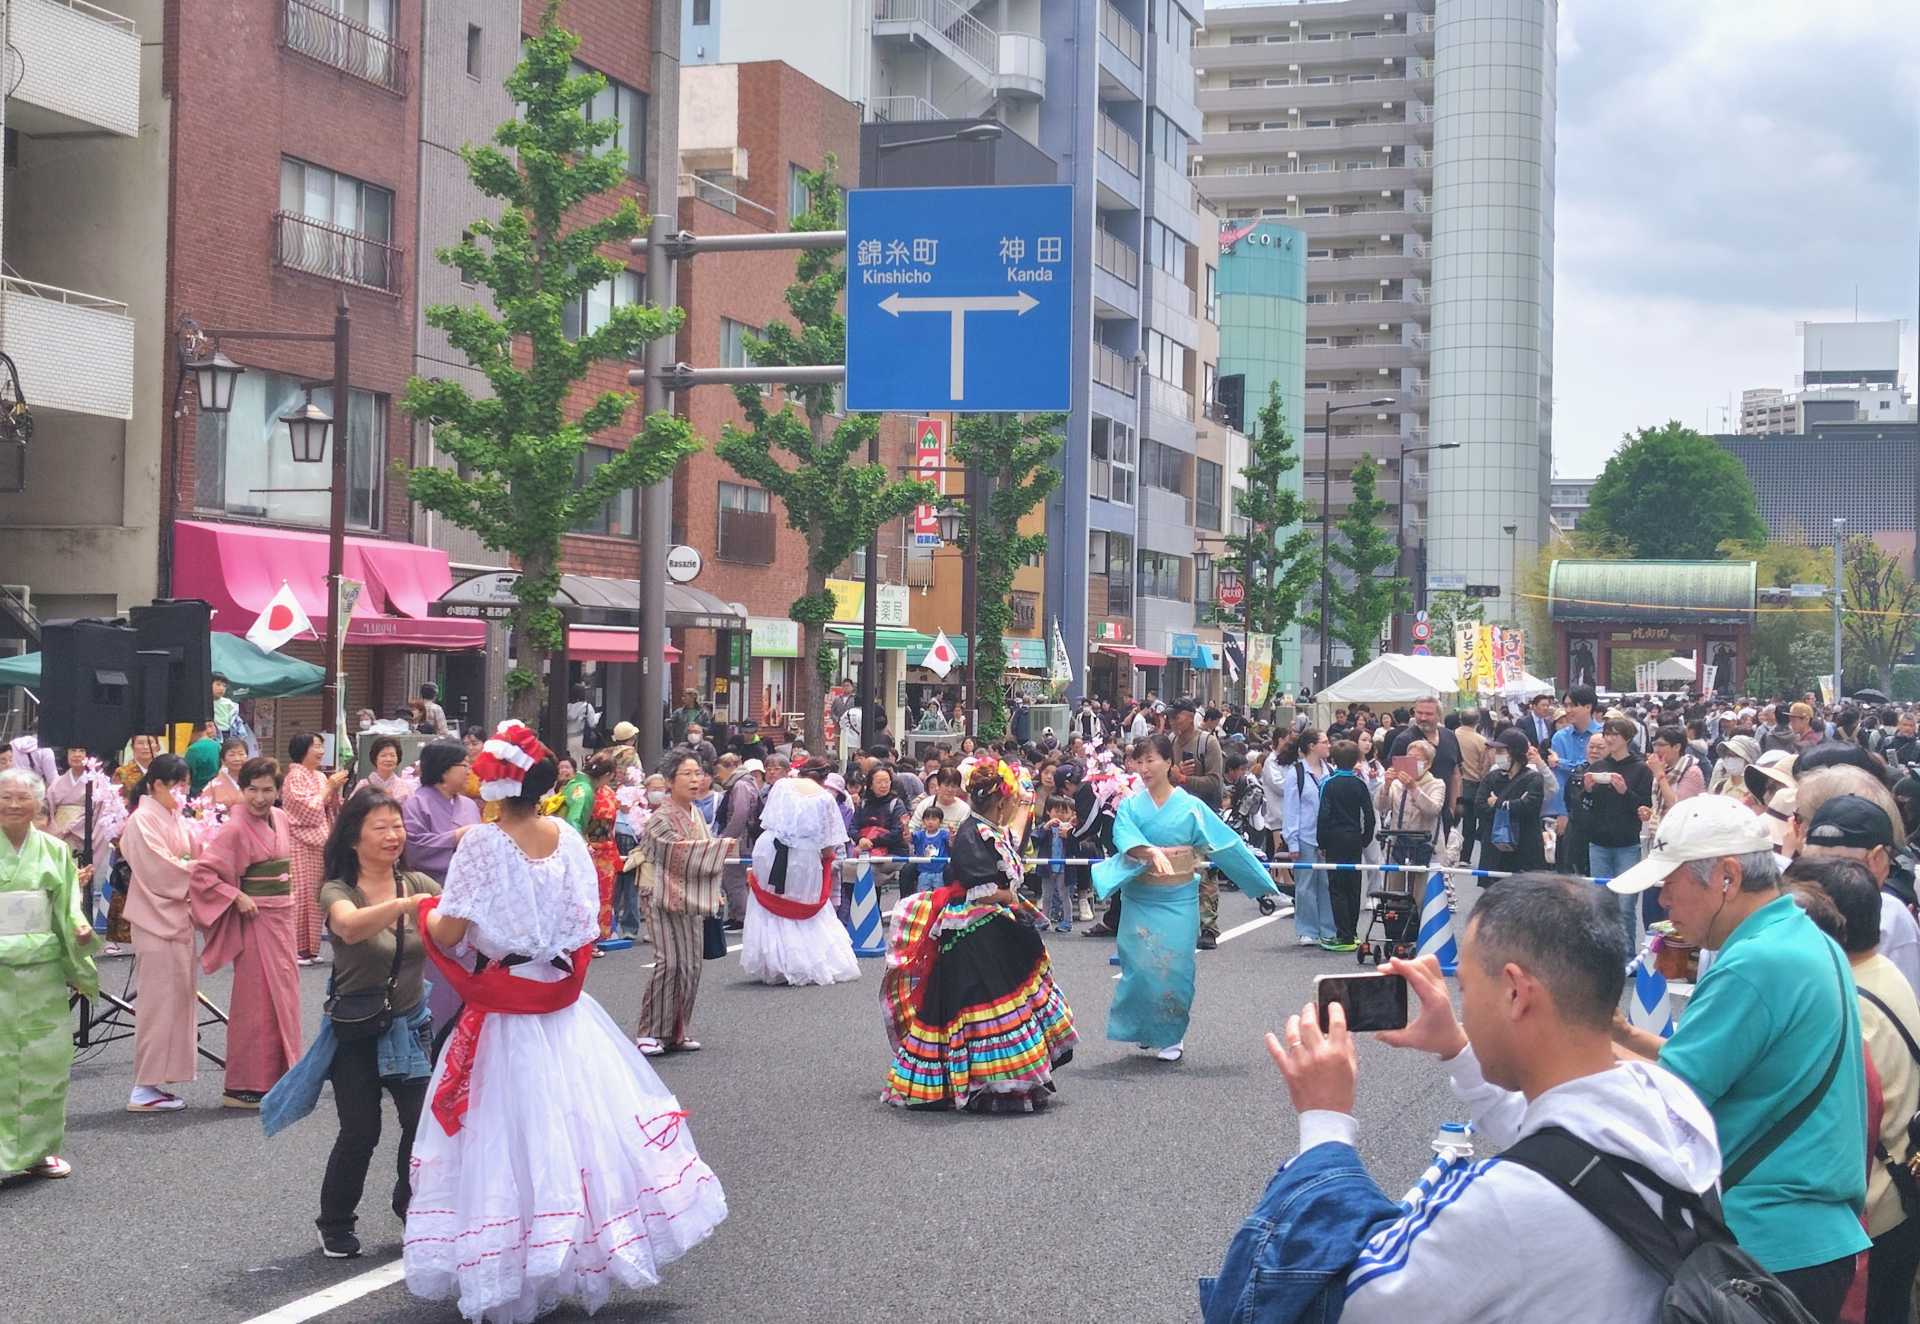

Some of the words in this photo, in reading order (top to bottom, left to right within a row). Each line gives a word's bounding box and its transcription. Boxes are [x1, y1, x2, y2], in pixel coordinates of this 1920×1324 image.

[857, 238, 938, 266] 錦糸町
[999, 236, 1062, 264] 神田
[863, 269, 932, 284] Kinshicho
[1007, 267, 1053, 282] Kanda
[919, 456, 941, 526] クリ
[1463, 631, 1473, 689] レモンサワー
